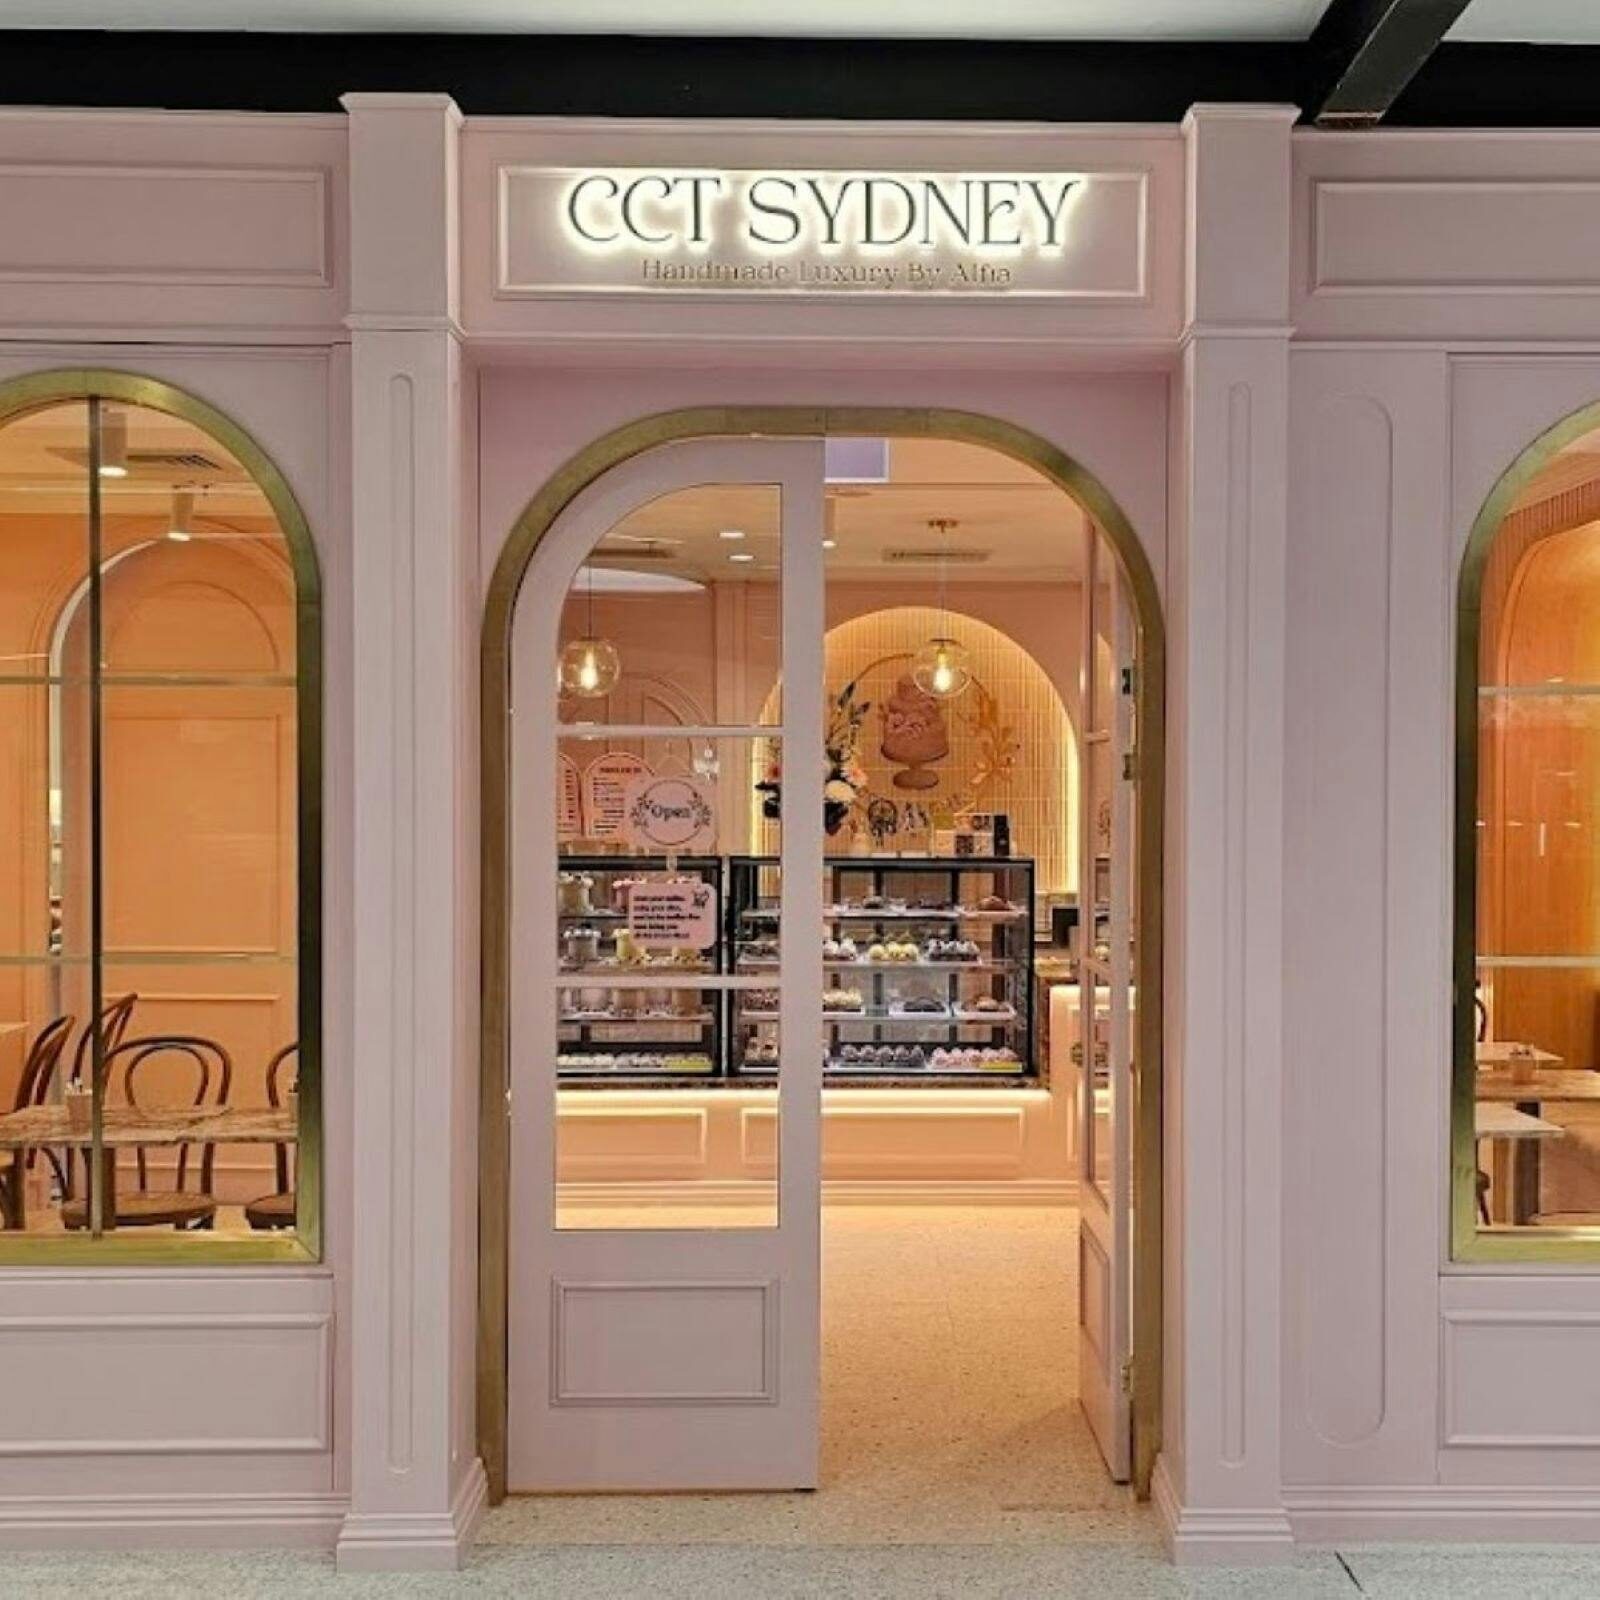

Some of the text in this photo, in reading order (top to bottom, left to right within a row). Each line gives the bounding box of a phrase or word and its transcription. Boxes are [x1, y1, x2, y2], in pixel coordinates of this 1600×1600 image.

[568, 175, 1081, 246] CCT SYDNEY
[642, 258, 1011, 289] Handmade Luxury By Alfia
[651, 804, 691, 822] Open
